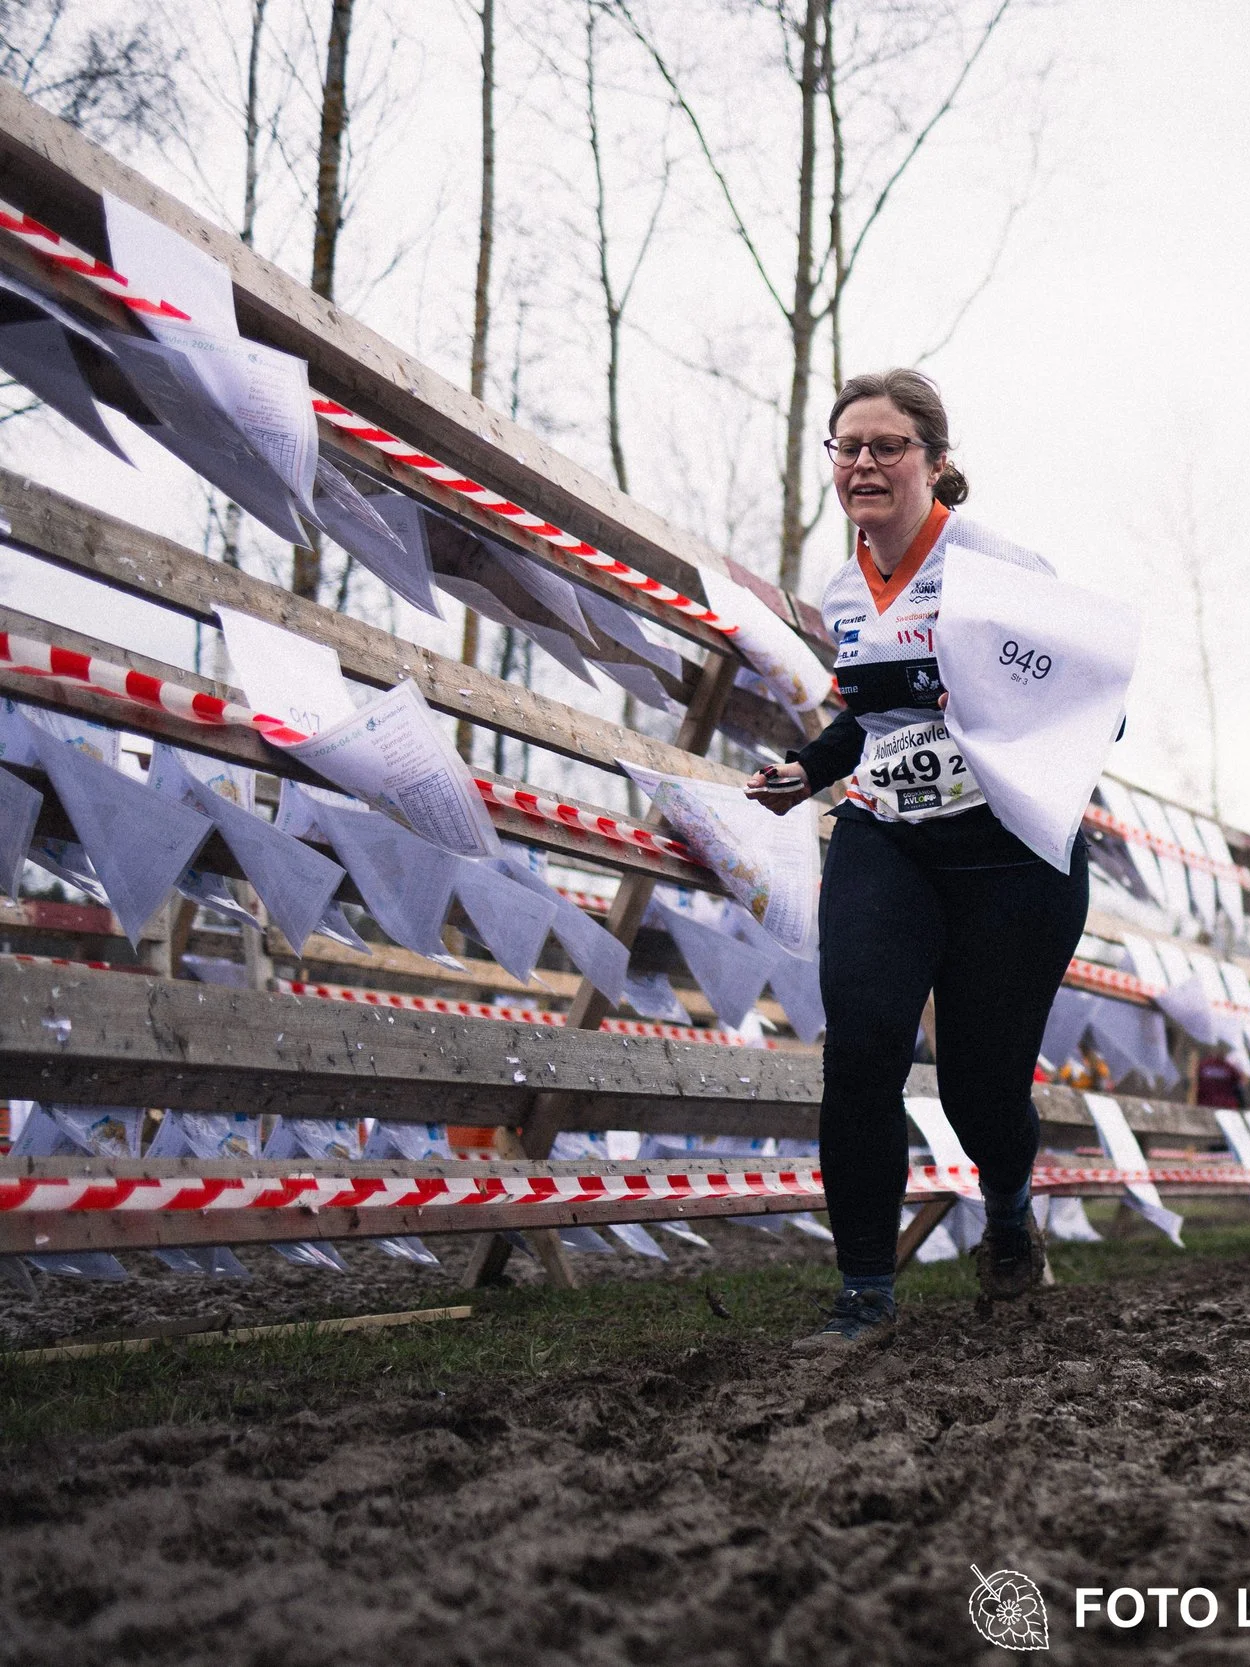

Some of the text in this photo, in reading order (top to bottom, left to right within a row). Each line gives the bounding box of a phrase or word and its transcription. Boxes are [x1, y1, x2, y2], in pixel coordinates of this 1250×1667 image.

[998, 640, 1052, 680] 949
[1010, 672, 1029, 686] Str 3
[870, 749, 967, 788] 949 2
